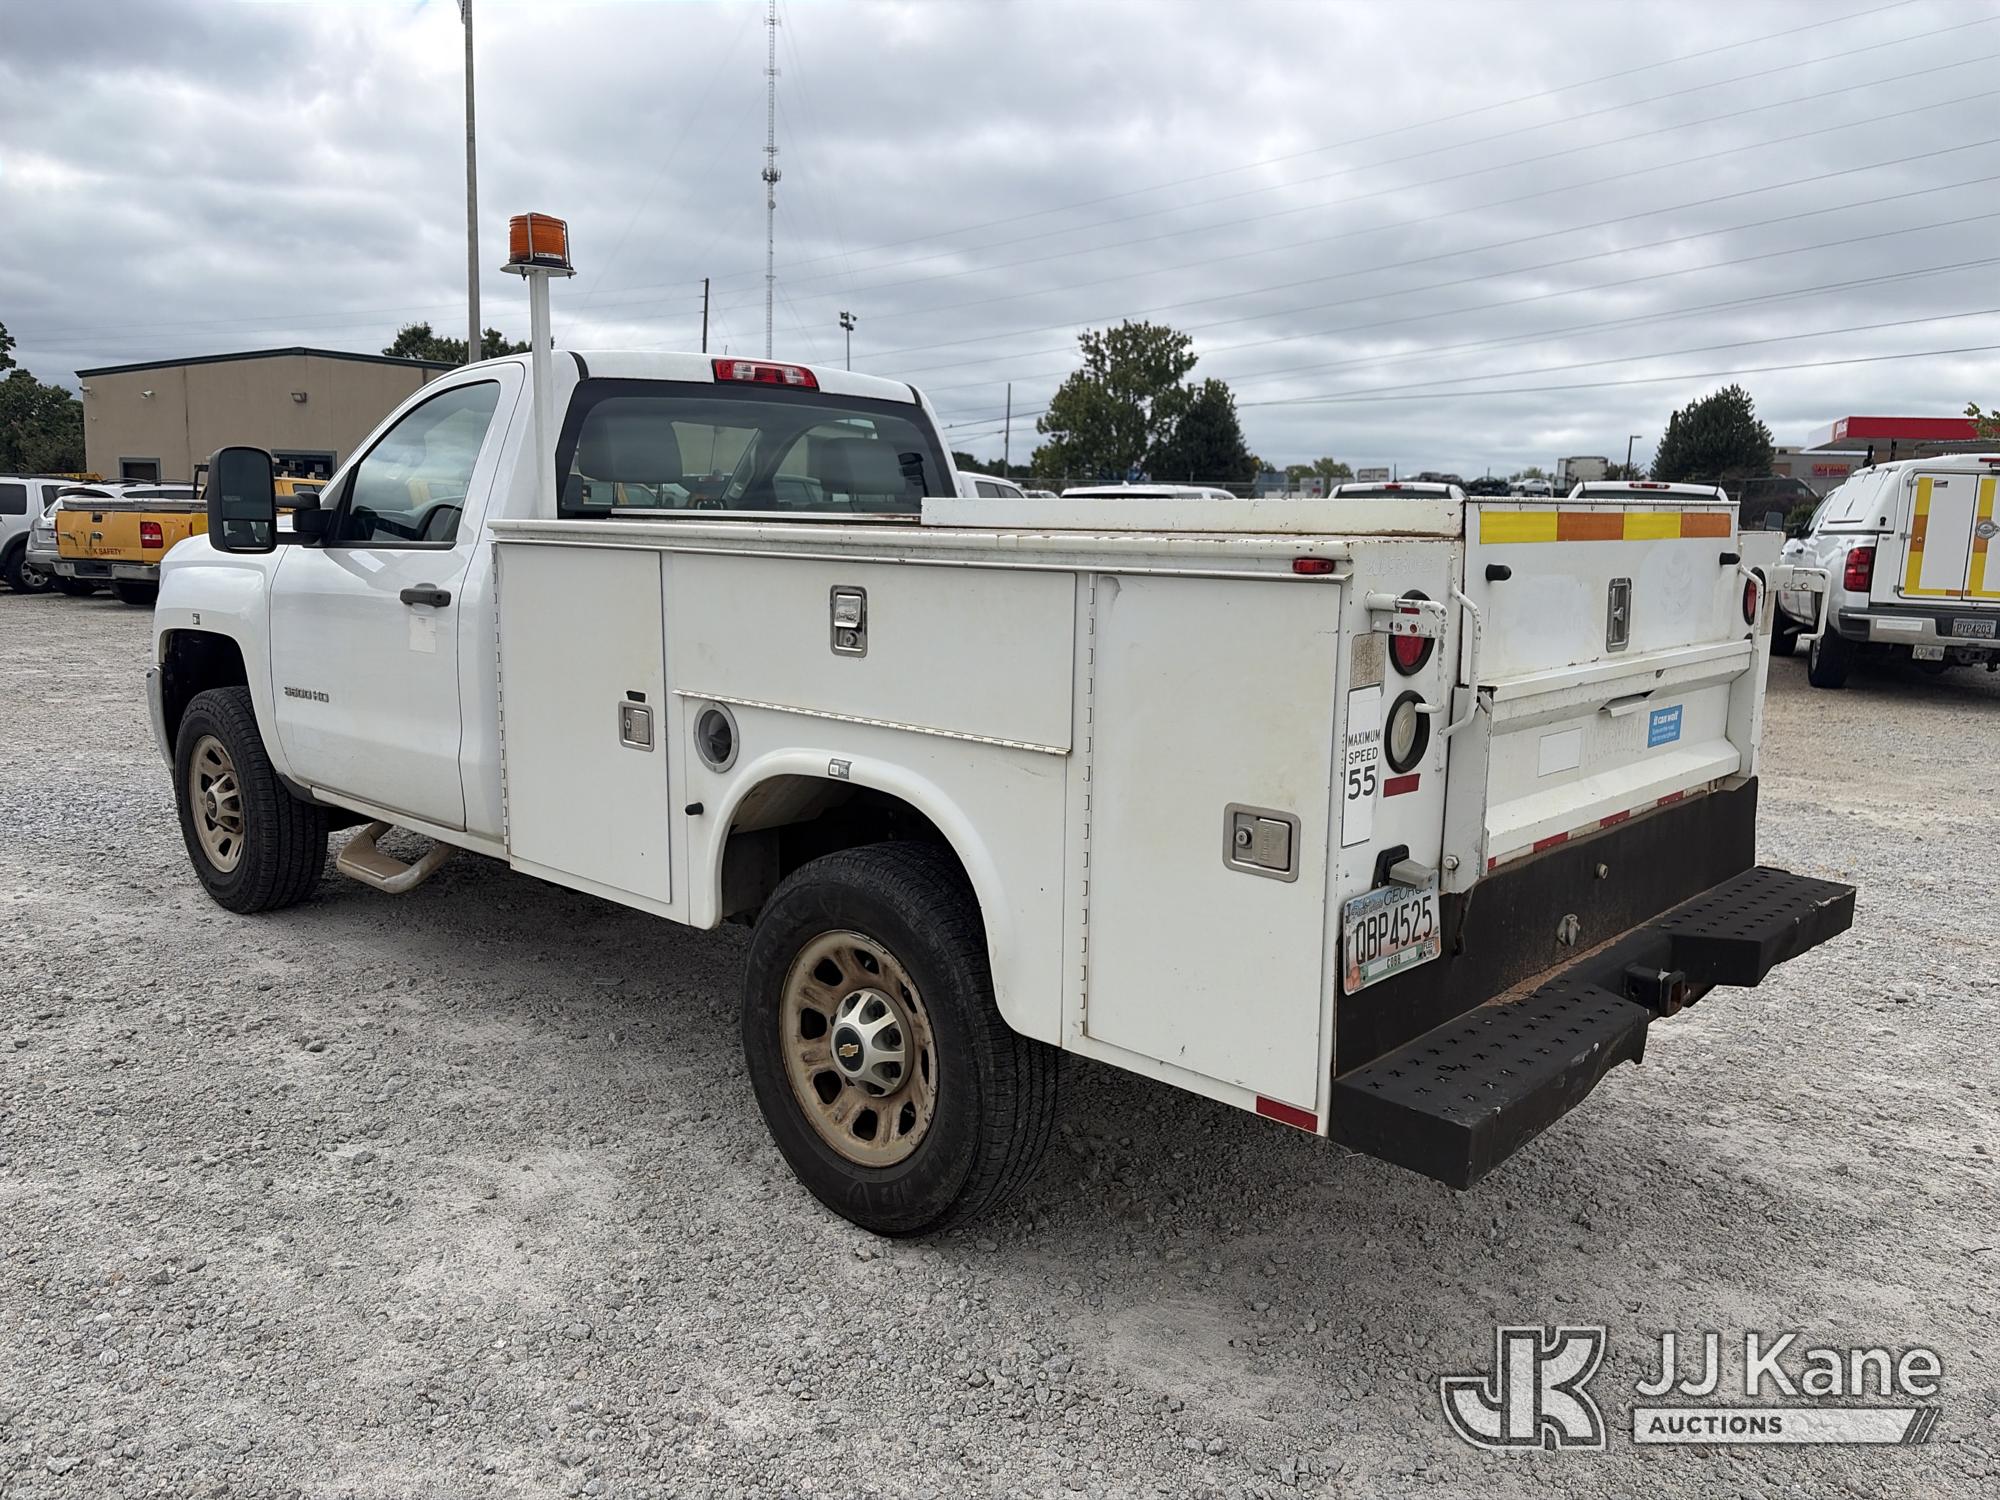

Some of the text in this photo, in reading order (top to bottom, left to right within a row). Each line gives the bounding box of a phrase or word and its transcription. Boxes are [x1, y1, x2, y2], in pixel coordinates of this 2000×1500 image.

[1348, 728, 1381, 747] MAXIMUM
[1348, 747, 1378, 765] SPEED
[1348, 765, 1376, 800] 55
